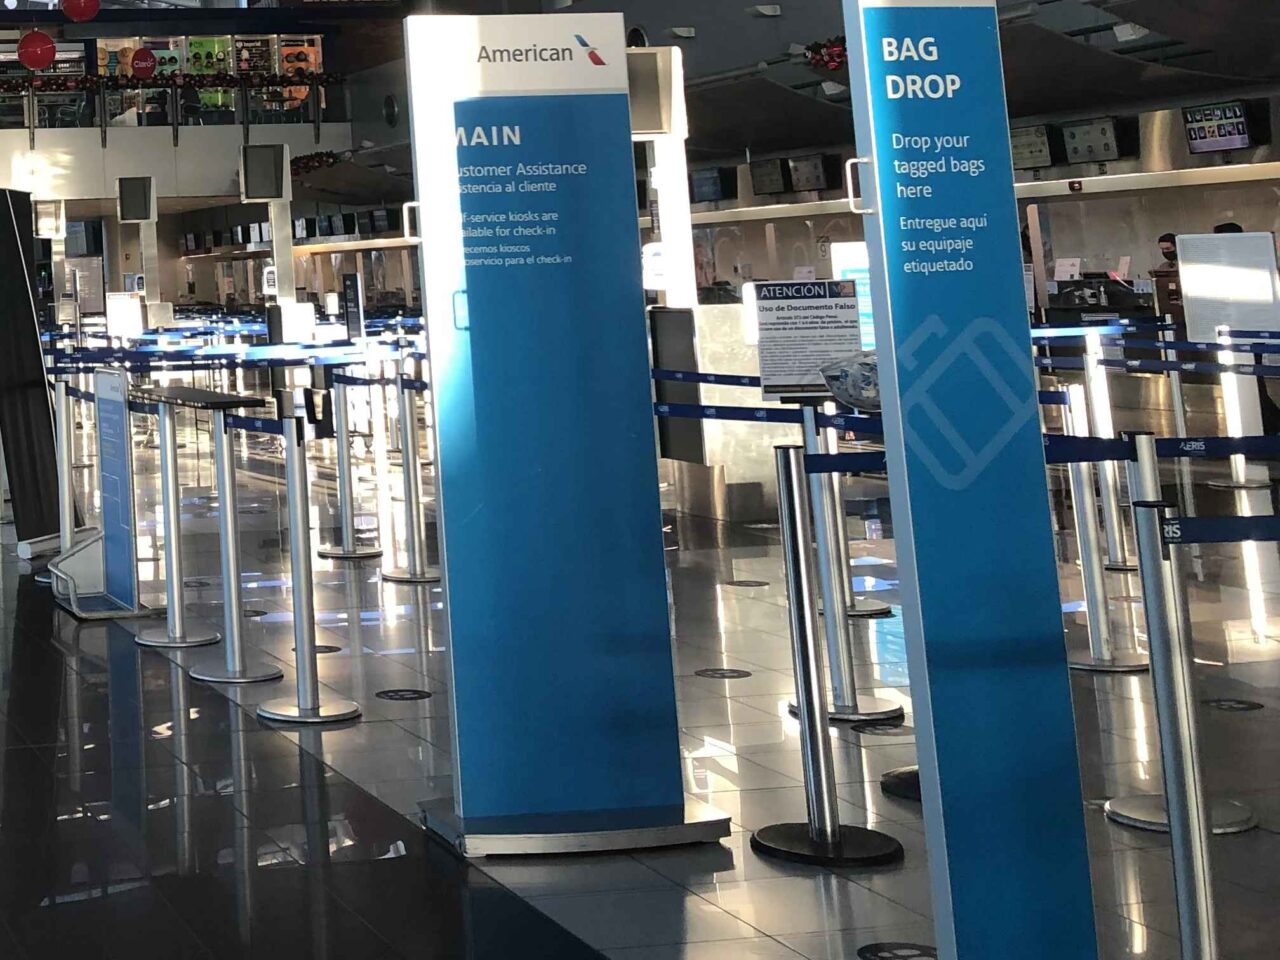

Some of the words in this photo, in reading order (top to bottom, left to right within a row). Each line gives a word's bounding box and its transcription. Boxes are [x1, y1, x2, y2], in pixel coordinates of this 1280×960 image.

[477, 44, 573, 62] American
[881, 36, 939, 62] BAG
[134, 59, 150, 68] Claro
[885, 73, 961, 99] DROP
[891, 133, 931, 152] Drop
[934, 135, 970, 153] your
[515, 162, 587, 176] Assistance
[893, 156, 946, 178] tagged
[950, 156, 985, 176] bags
[505, 181, 515, 192] al
[518, 180, 557, 192] cliente
[896, 182, 932, 198] here
[508, 211, 539, 221] kiosks
[541, 213, 559, 221] are
[900, 216, 957, 233] Entregue
[960, 213, 988, 231] aquí
[495, 226, 511, 236] for
[513, 225, 556, 236] check-in
[499, 244, 531, 253] kioscos
[901, 240, 916, 251] su
[919, 236, 974, 254] equipaje
[505, 257, 524, 267] para
[526, 255, 535, 265] el
[536, 254, 572, 264] check-in
[903, 258, 974, 276] etiquetado
[760, 283, 825, 298] ATENCIÓN
[775, 304, 786, 312] de
[787, 303, 834, 311] Documento
